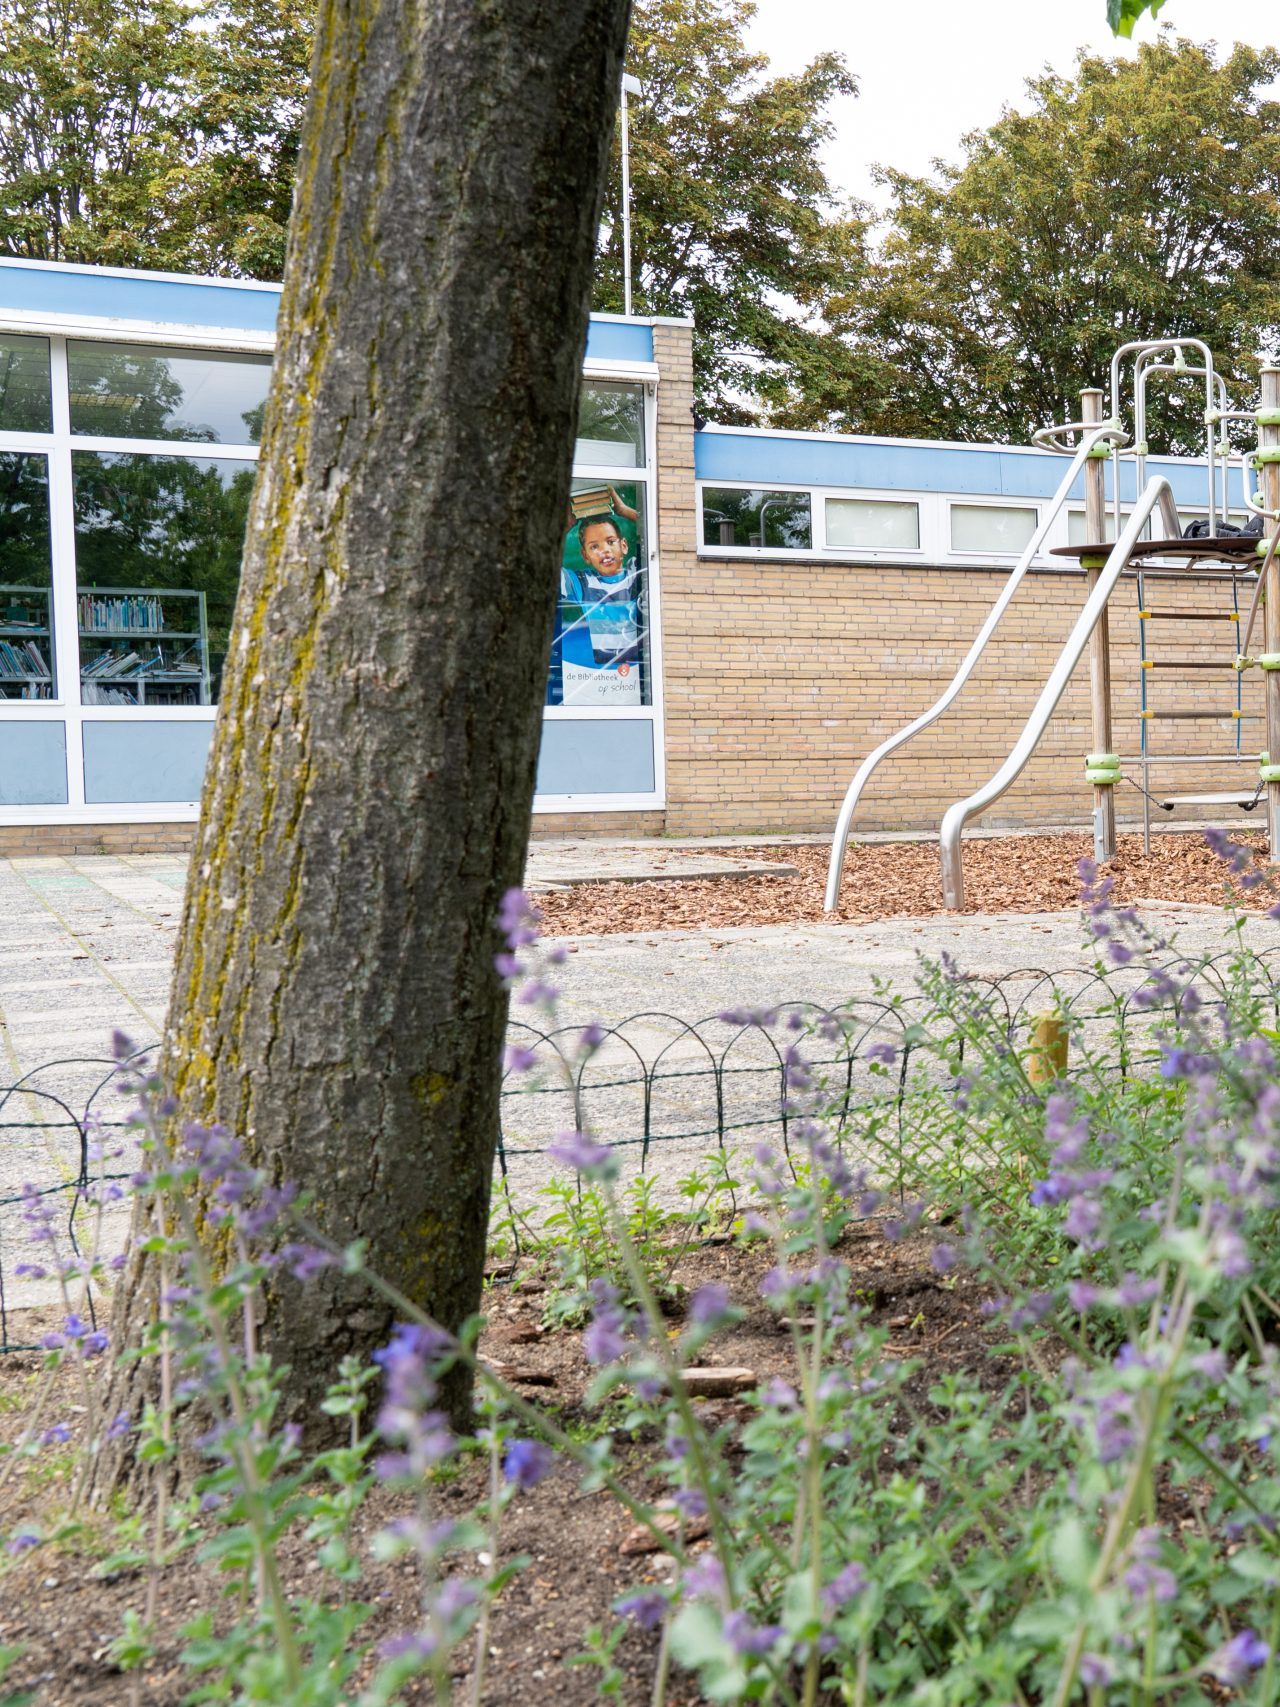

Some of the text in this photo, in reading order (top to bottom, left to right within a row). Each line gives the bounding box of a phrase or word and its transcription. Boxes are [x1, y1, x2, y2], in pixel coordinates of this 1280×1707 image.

[566, 673, 576, 681] de
[598, 680, 637, 696] op school
